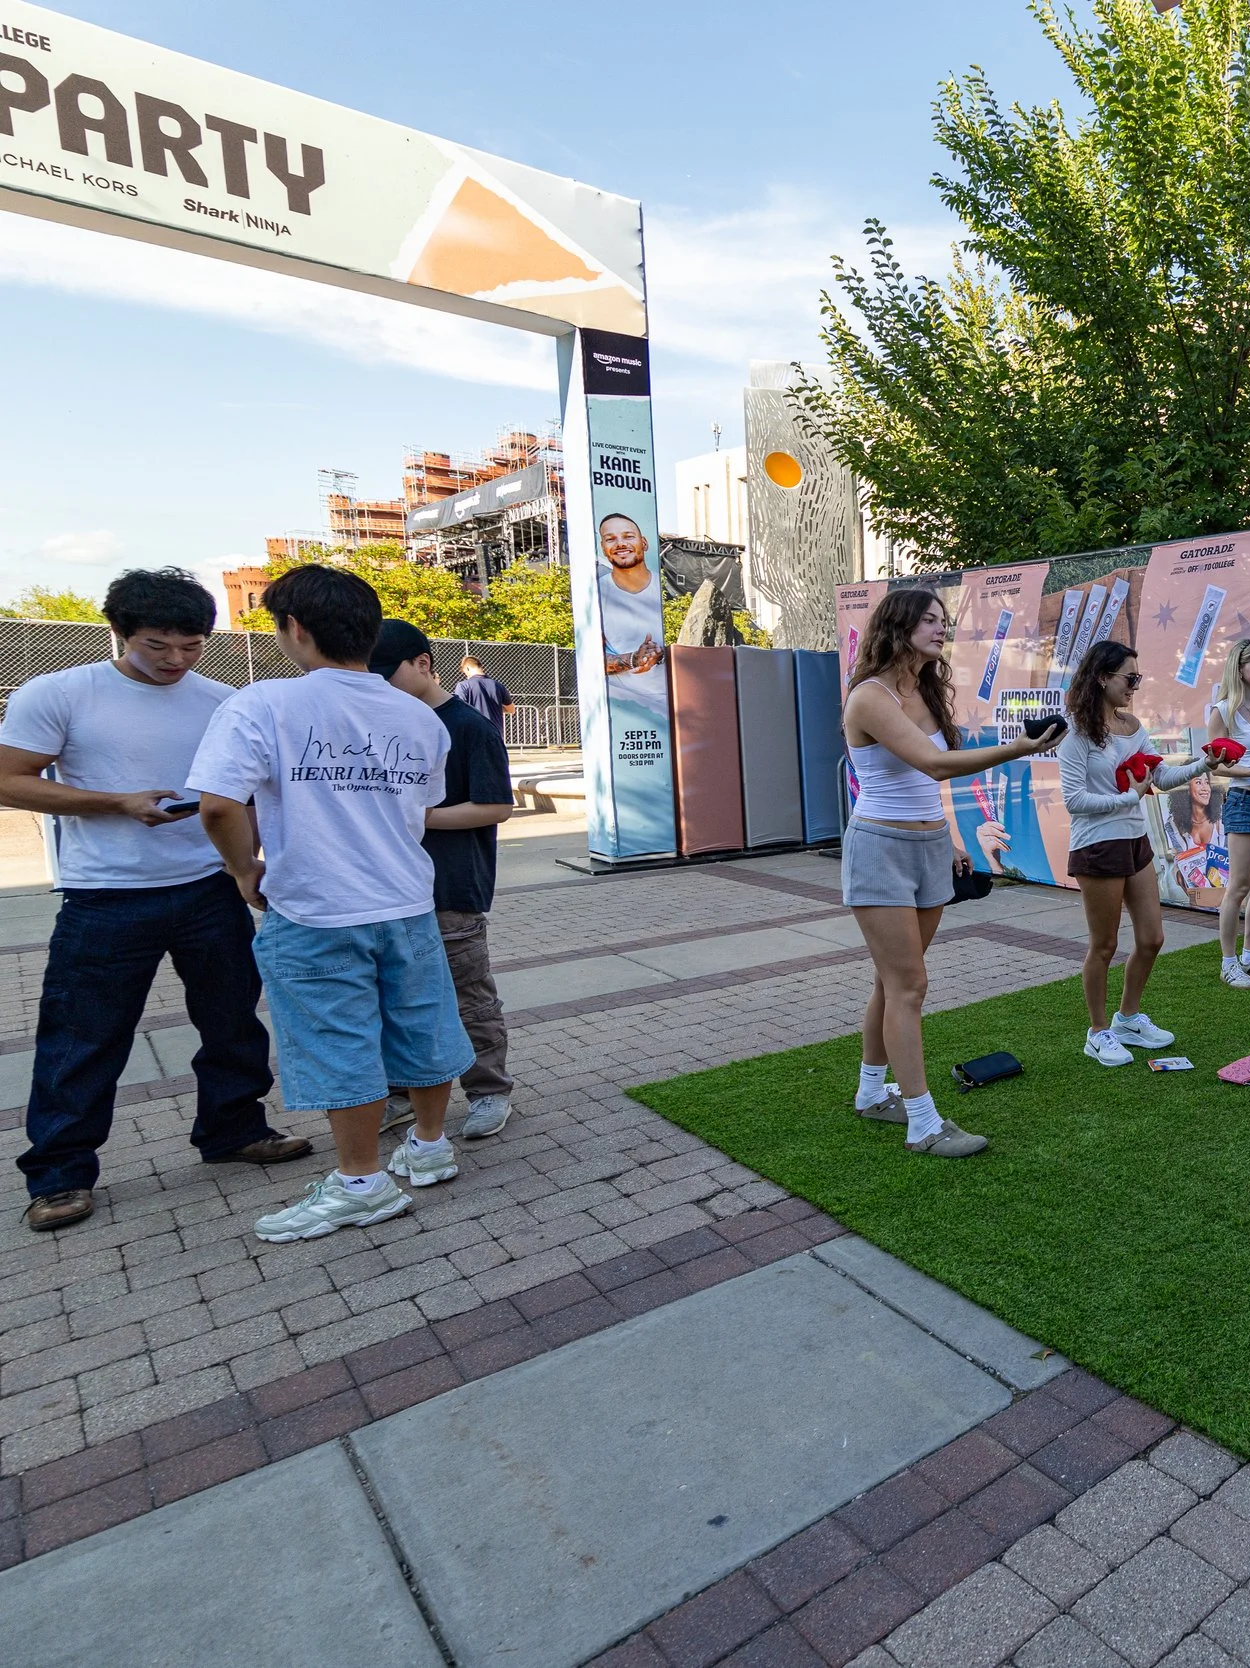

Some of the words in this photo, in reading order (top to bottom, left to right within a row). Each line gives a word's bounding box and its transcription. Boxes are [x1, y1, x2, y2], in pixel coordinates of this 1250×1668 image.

[0, 52, 326, 216] PARTY
[83, 172, 138, 197] KORS
[183, 198, 240, 224] Shark
[245, 212, 292, 237] NINJA
[593, 352, 620, 364] amazon
[621, 358, 642, 366] music
[606, 366, 630, 374] presents
[605, 444, 629, 452] CONCERT
[630, 446, 646, 454] EVENT
[600, 454, 641, 475] KANE
[593, 471, 652, 494] BROWN
[1180, 543, 1236, 560] GATORADE
[1188, 564, 1199, 573] OFF
[1212, 560, 1236, 570] COLLEGE
[986, 573, 1022, 586] GATORADE
[840, 590, 869, 598] GATORADE
[986, 642, 1000, 686] propel
[1001, 690, 1060, 706] HYDRATION
[996, 708, 1014, 722] FOR
[625, 730, 648, 740] SEPT
[650, 730, 656, 740] 5
[620, 741, 642, 750] 7:30
[646, 740, 662, 750] PM
[290, 766, 354, 782] HENRI
[332, 784, 346, 792] The
[1207, 850, 1230, 866] prop
